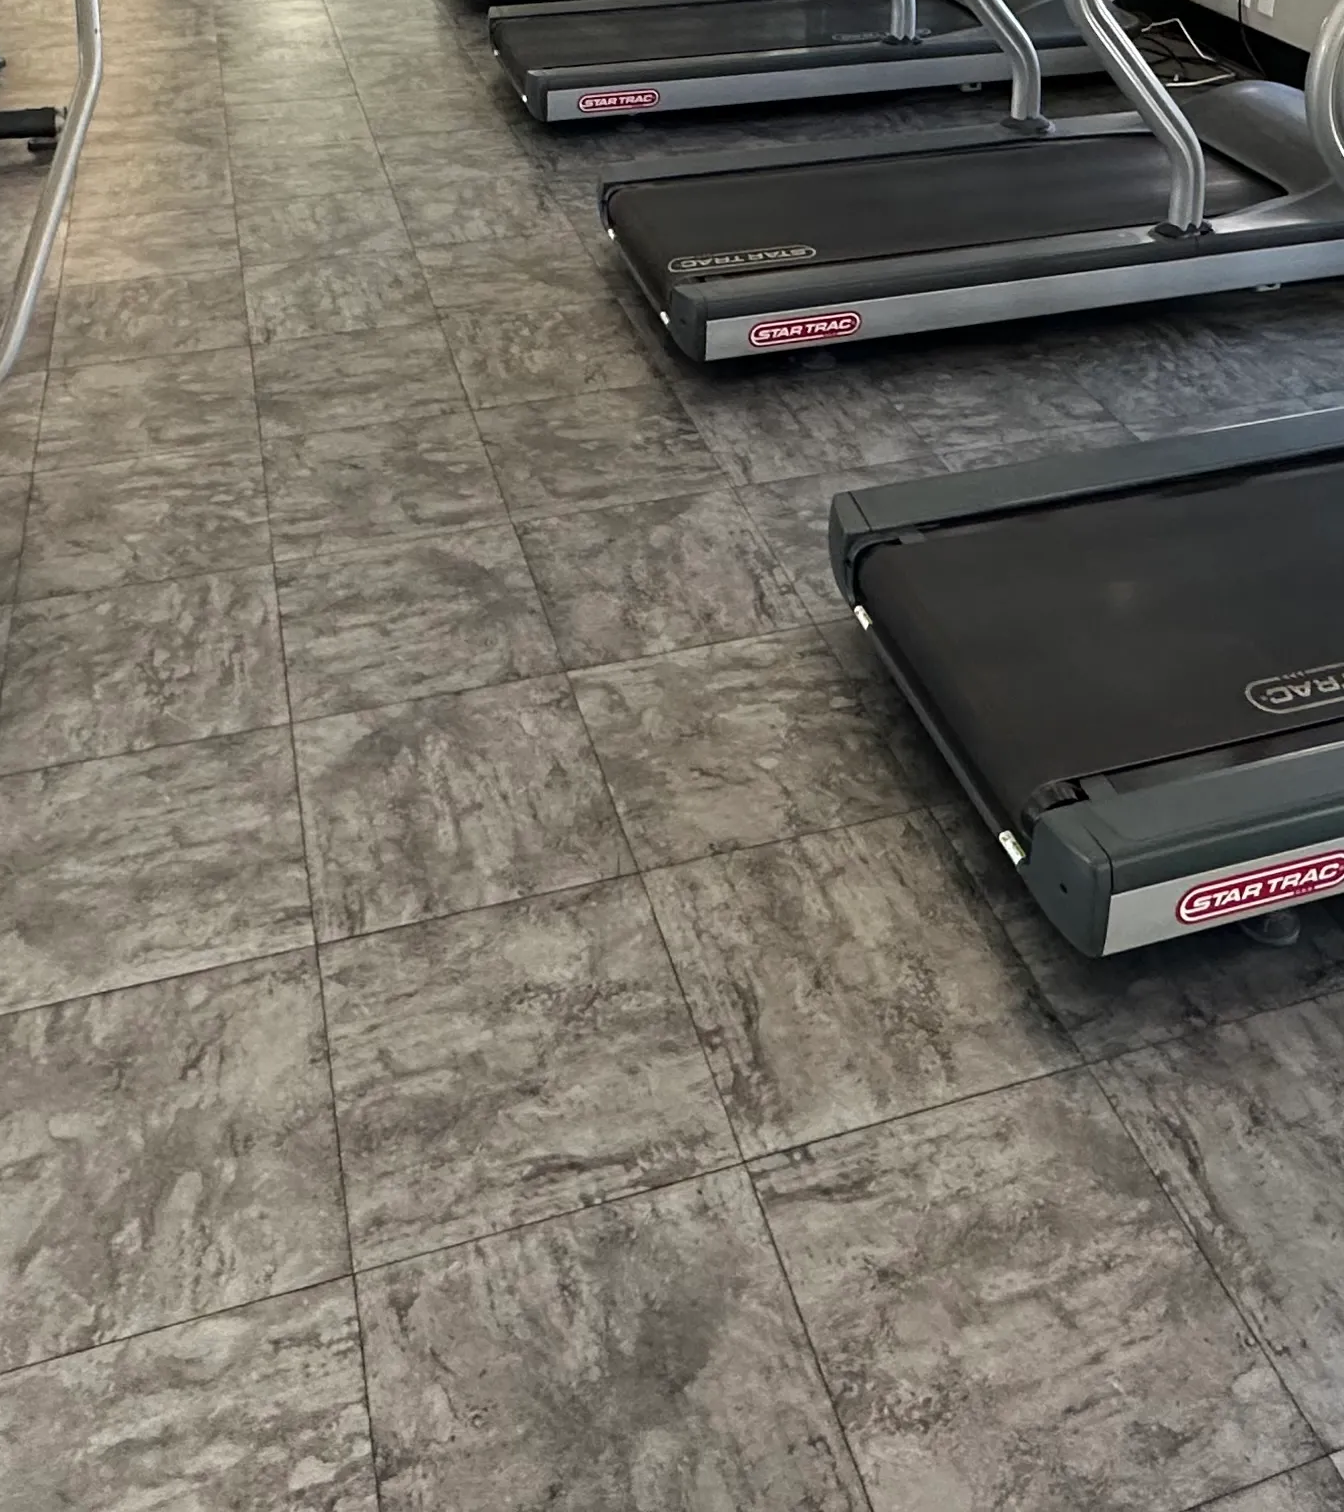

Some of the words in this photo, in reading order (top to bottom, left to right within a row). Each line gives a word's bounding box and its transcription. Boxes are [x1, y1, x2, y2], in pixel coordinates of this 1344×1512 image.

[584, 97, 617, 108] STAR
[619, 94, 653, 104] TRAC
[747, 248, 806, 260] STAR
[680, 255, 745, 268] TRAC
[758, 325, 803, 339] STAR
[805, 319, 852, 333] TRAC
[1193, 882, 1263, 911] STAR
[1267, 863, 1340, 892] TRAC
